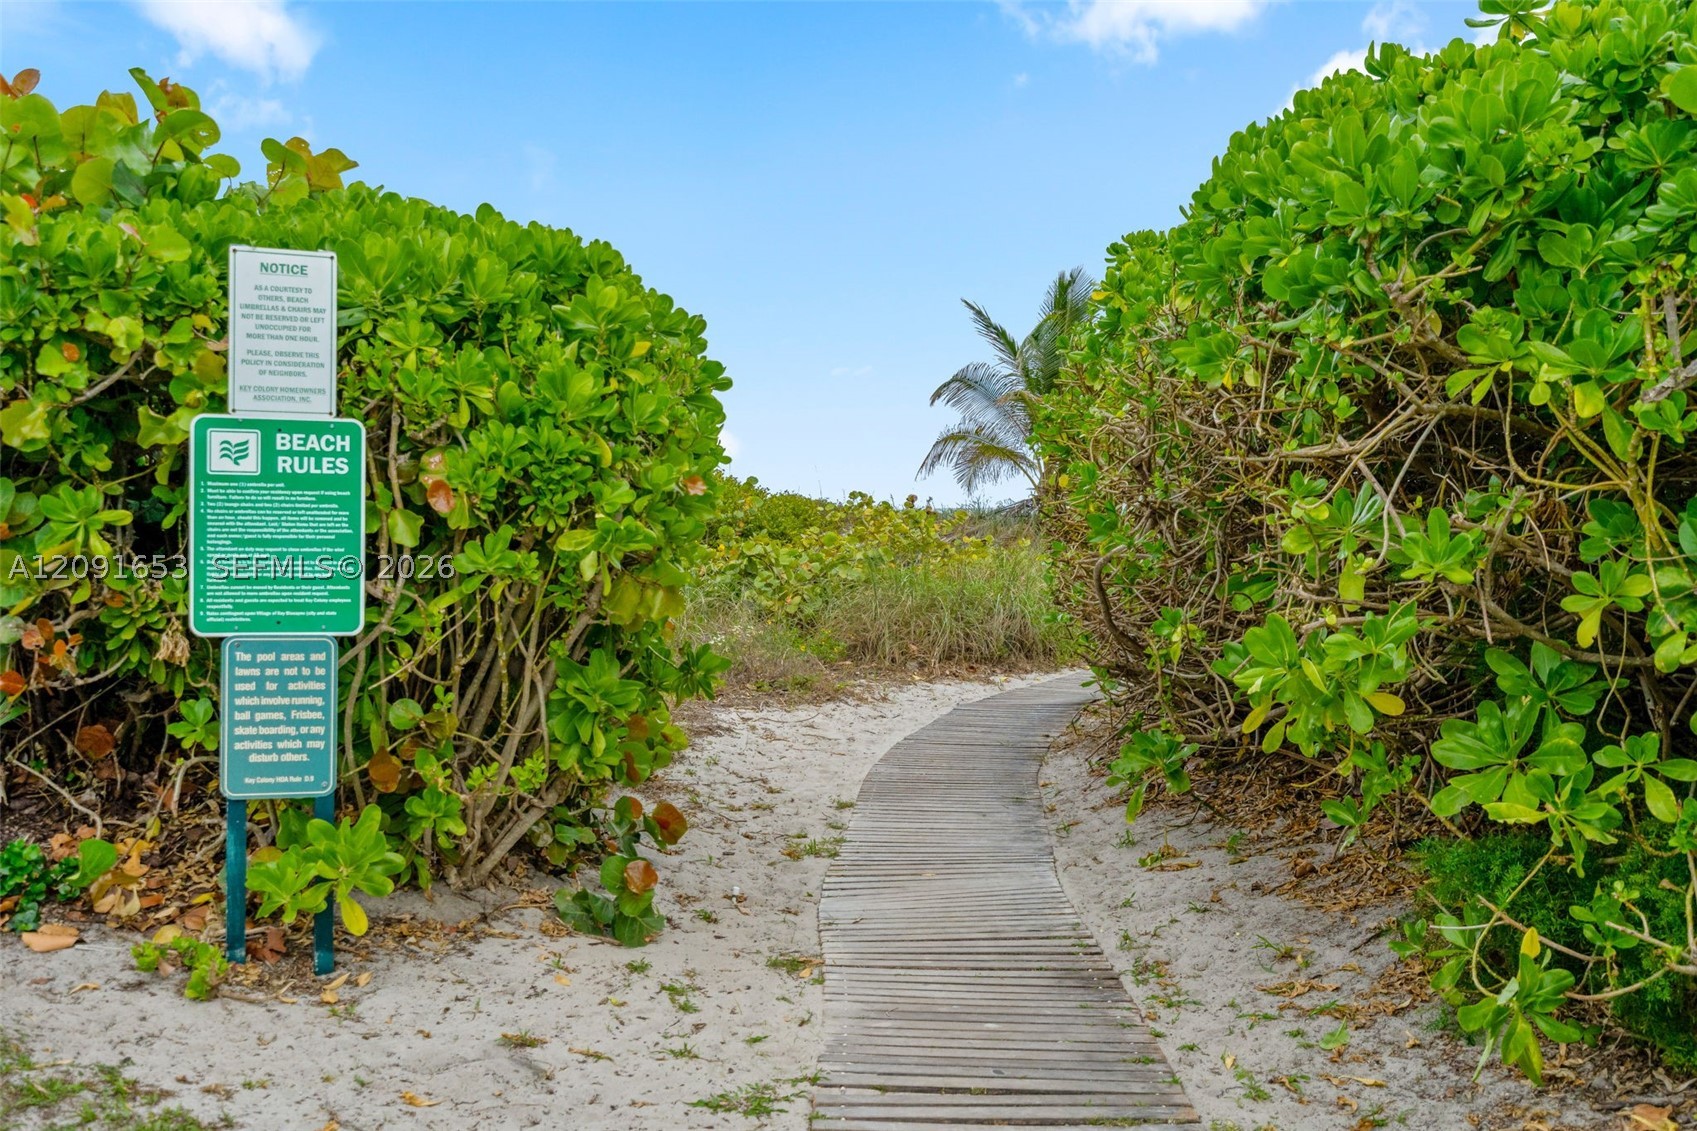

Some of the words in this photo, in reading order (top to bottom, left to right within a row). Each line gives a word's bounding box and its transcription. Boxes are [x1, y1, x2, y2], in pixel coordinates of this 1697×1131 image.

[260, 262, 308, 275] NOTICE
[276, 434, 350, 452] BEACH
[277, 456, 349, 474] RULES
[235, 652, 251, 661] The
[257, 652, 275, 663] pool
[310, 652, 326, 661] and
[235, 667, 260, 676] lawns
[284, 667, 298, 675] not
[302, 667, 310, 676] to
[315, 667, 326, 675] be
[235, 682, 256, 691] used
[266, 681, 278, 690] for
[288, 681, 326, 690] activities
[234, 696, 260, 705] which
[261, 696, 290, 705] involve
[291, 696, 324, 706] running,
[234, 711, 250, 720] ball
[254, 712, 286, 722] games,
[291, 710, 324, 720] Frisbee,
[234, 726, 257, 735] skate
[258, 725, 298, 736] boarding,
[310, 726, 325, 735] any
[234, 740, 272, 750] activities
[277, 740, 302, 749] which
[306, 741, 325, 750] may
[249, 753, 279, 762] disturb
[280, 752, 310, 762] others.
